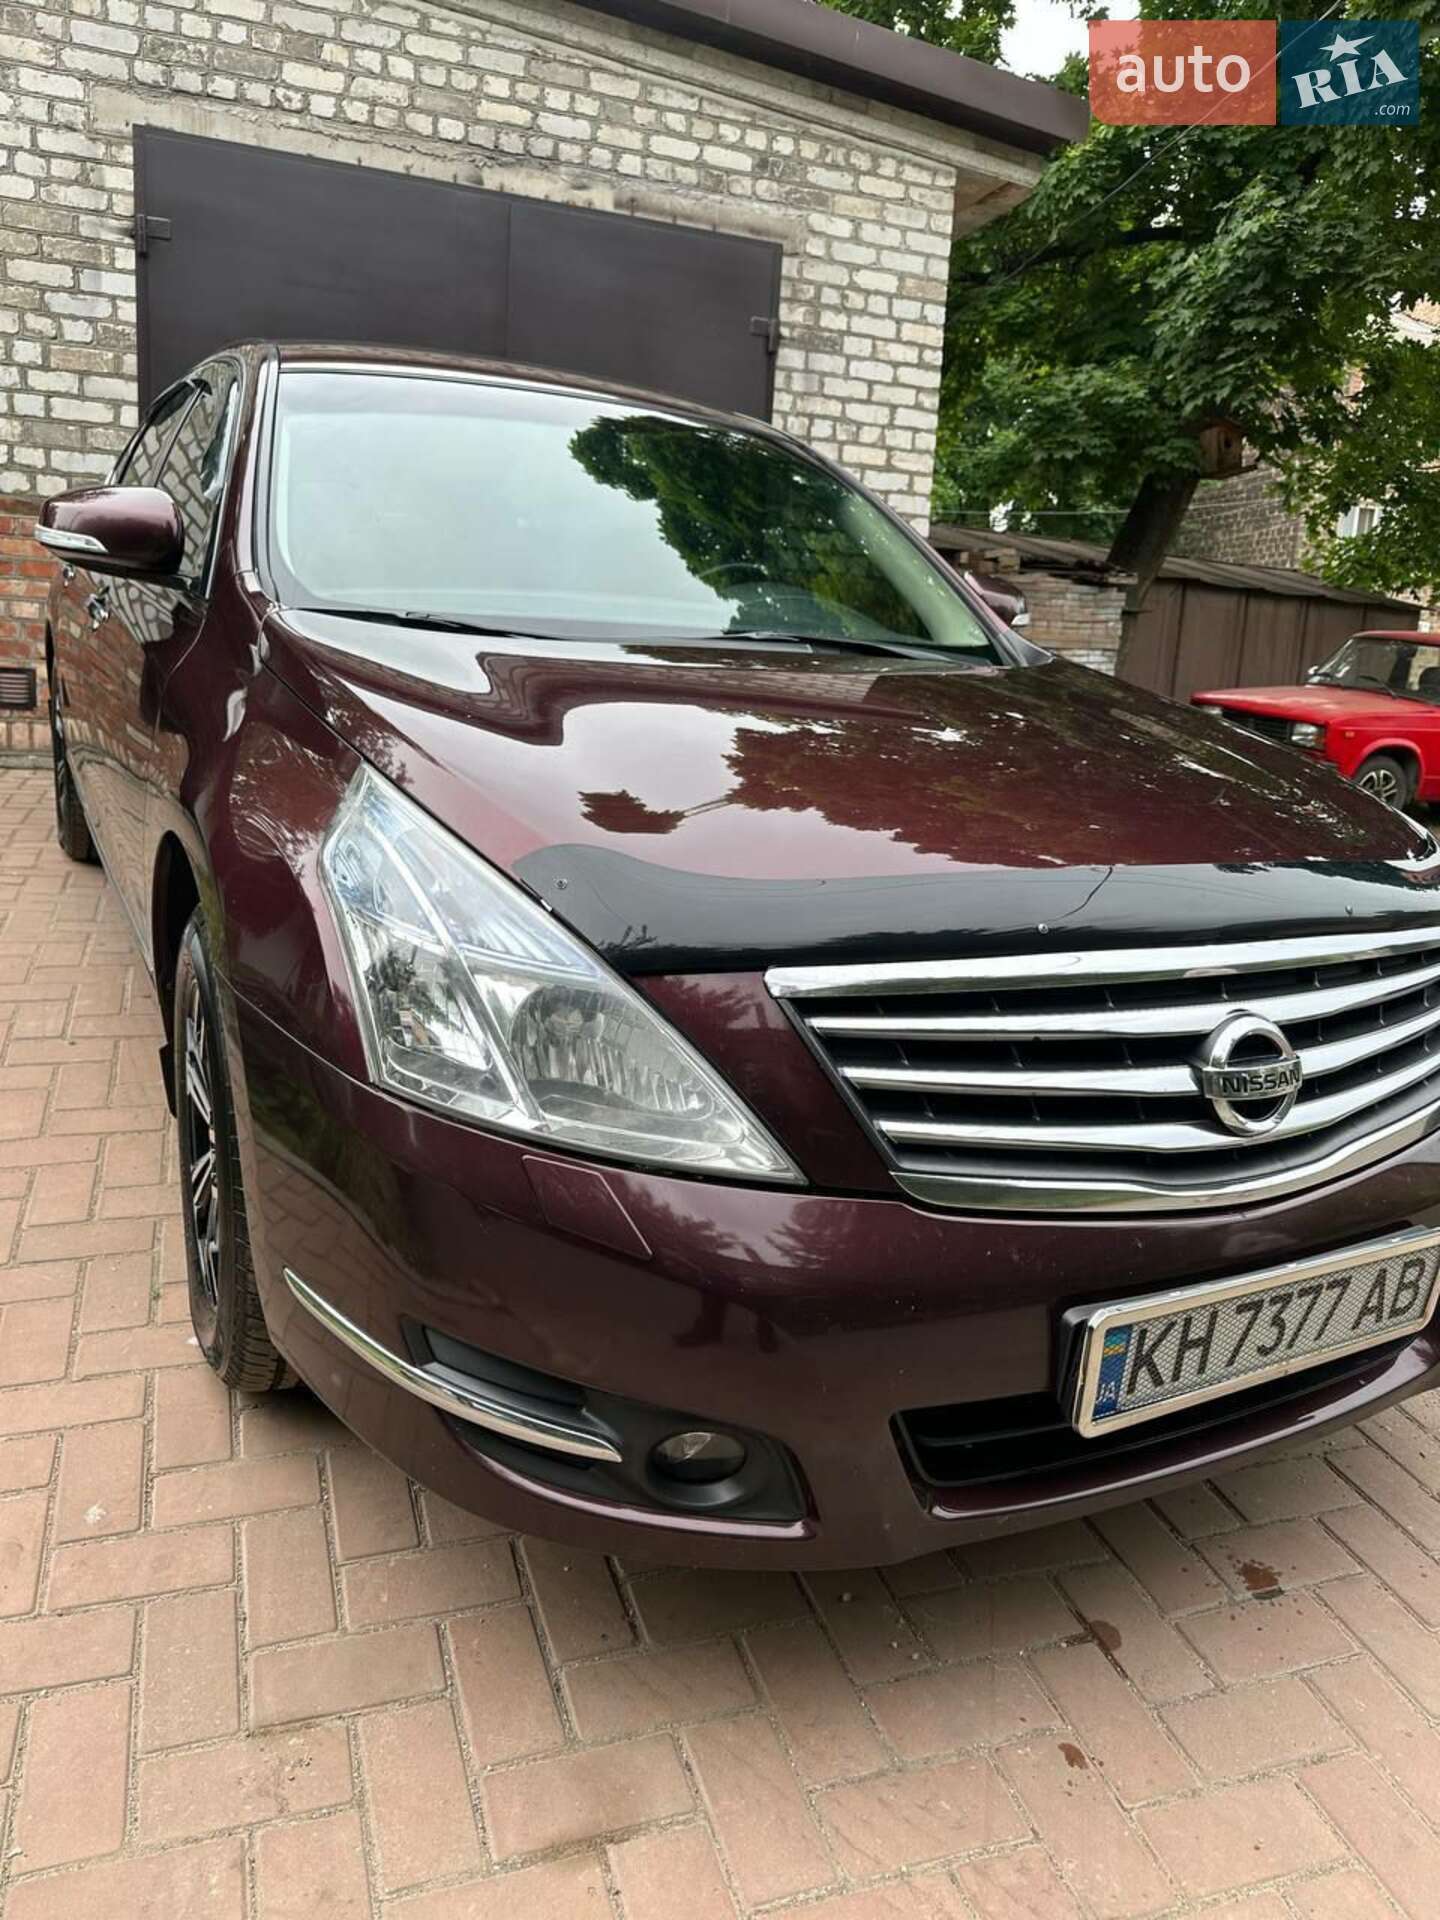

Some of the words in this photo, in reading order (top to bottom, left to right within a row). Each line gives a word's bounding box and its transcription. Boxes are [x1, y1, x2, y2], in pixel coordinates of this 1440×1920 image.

[1221, 1069, 1300, 1094] NISSAN
[1125, 1309, 1218, 1396] KH
[1225, 1273, 1353, 1369] 7377
[1351, 1256, 1426, 1331] AB
